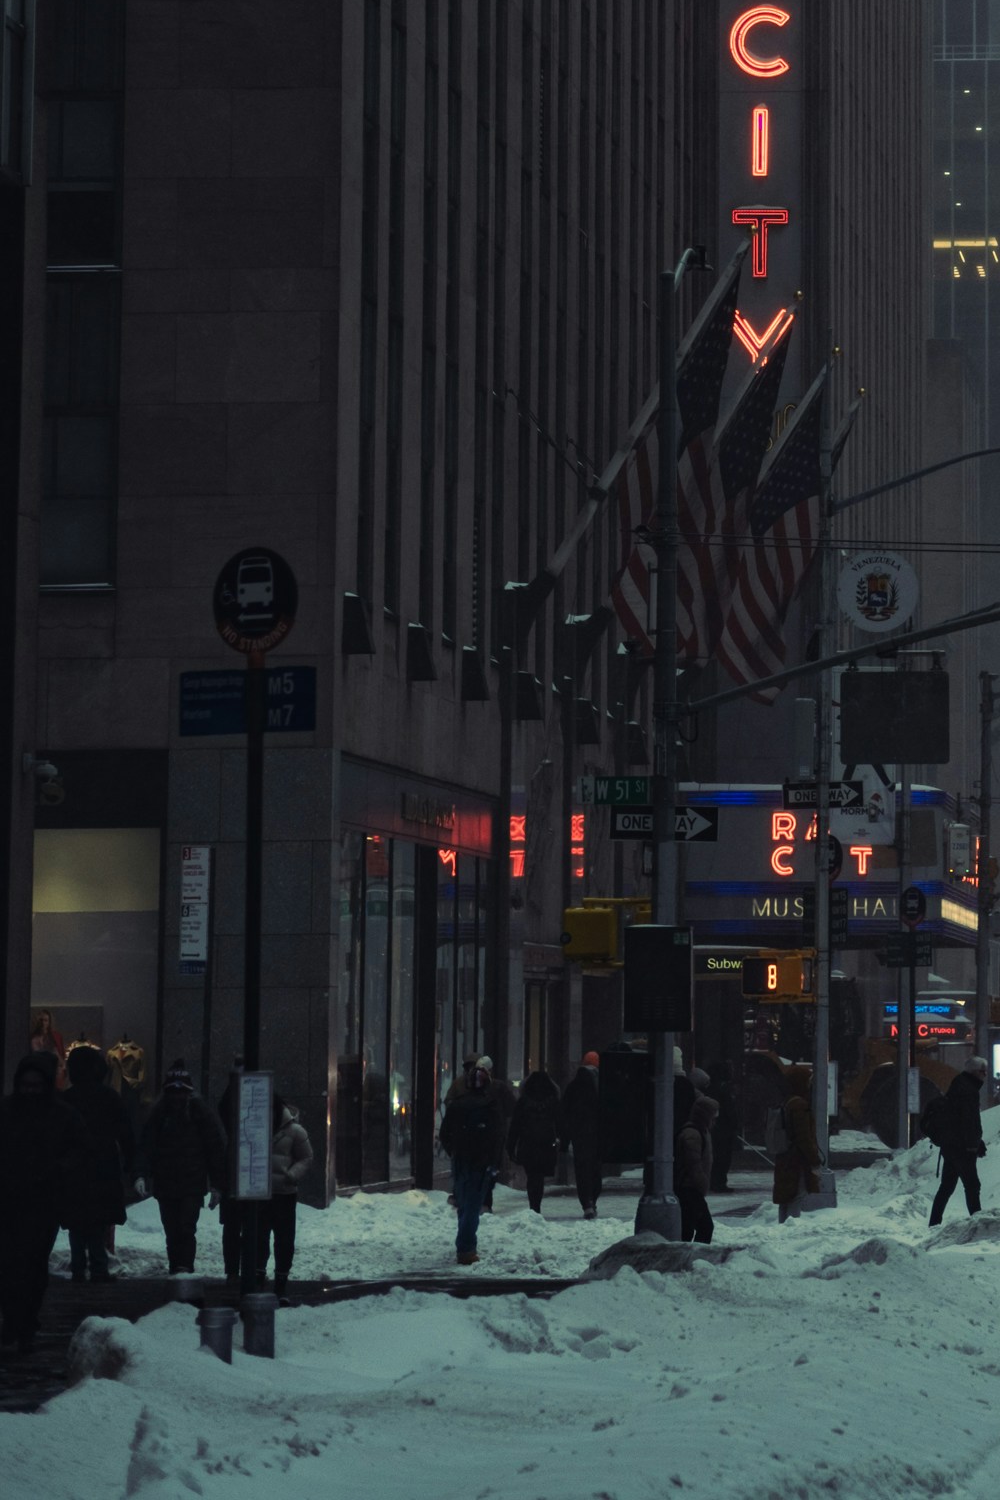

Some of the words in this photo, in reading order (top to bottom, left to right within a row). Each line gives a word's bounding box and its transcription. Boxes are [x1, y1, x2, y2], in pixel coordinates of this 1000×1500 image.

[729, 4, 794, 367] CITY
[851, 557, 901, 571] VENEZUELA
[221, 625, 238, 643] NO
[238, 622, 288, 652] STANDING
[268, 672, 294, 695] M5
[268, 704, 294, 727] M7
[596, 779, 609, 801] W
[615, 780, 629, 801] 51
[635, 779, 645, 793] St
[794, 791, 817, 801] ONE
[840, 808, 885, 816] MORMN
[621, 815, 651, 830] ONE
[675, 816, 697, 831] AY
[752, 898, 805, 917] MUS
[707, 957, 743, 970] Subw
[890, 1024, 929, 1037] NC
[930, 1027, 956, 1035] STUDIOS
